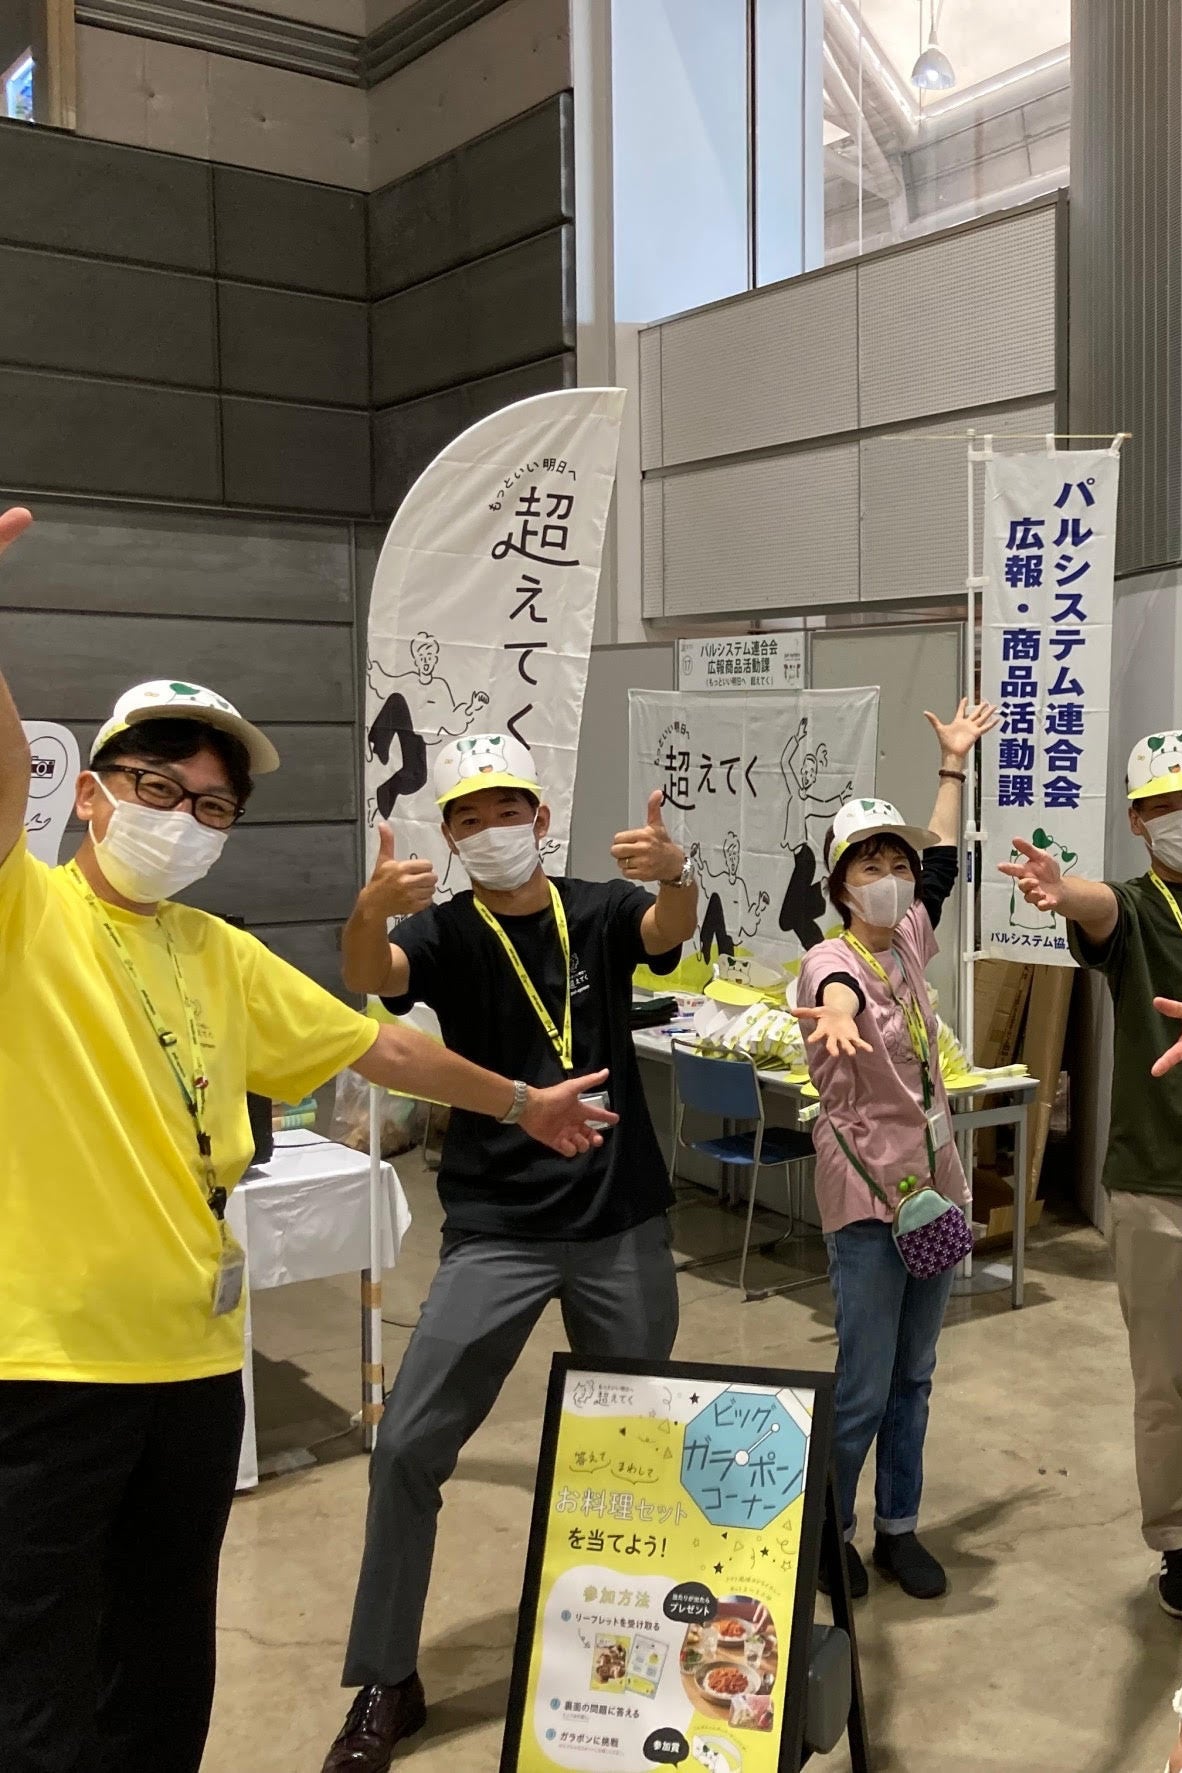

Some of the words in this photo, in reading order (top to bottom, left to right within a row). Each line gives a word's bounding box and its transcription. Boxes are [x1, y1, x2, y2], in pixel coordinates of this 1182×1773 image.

[488, 458, 576, 511] もっといい明日へ
[491, 486, 580, 751] 超えてく
[701, 639, 778, 657] パルシステム連合会
[1043, 477, 1096, 809] パルシステム連合会
[707, 658, 770, 675] 広報商品活動課
[998, 517, 1045, 807] 広報・商品活動課
[660, 745, 757, 810] 超えてく
[991, 932, 1070, 950] パルシステム協
[714, 1398, 777, 1434] ビッグ
[556, 1485, 688, 1526] お料理セット
[701, 1487, 776, 1520] コーナー
[583, 1584, 651, 1609] 参加方法
[670, 1603, 710, 1617] プレゼント
[575, 1613, 661, 1632] リーフレットを受け取る
